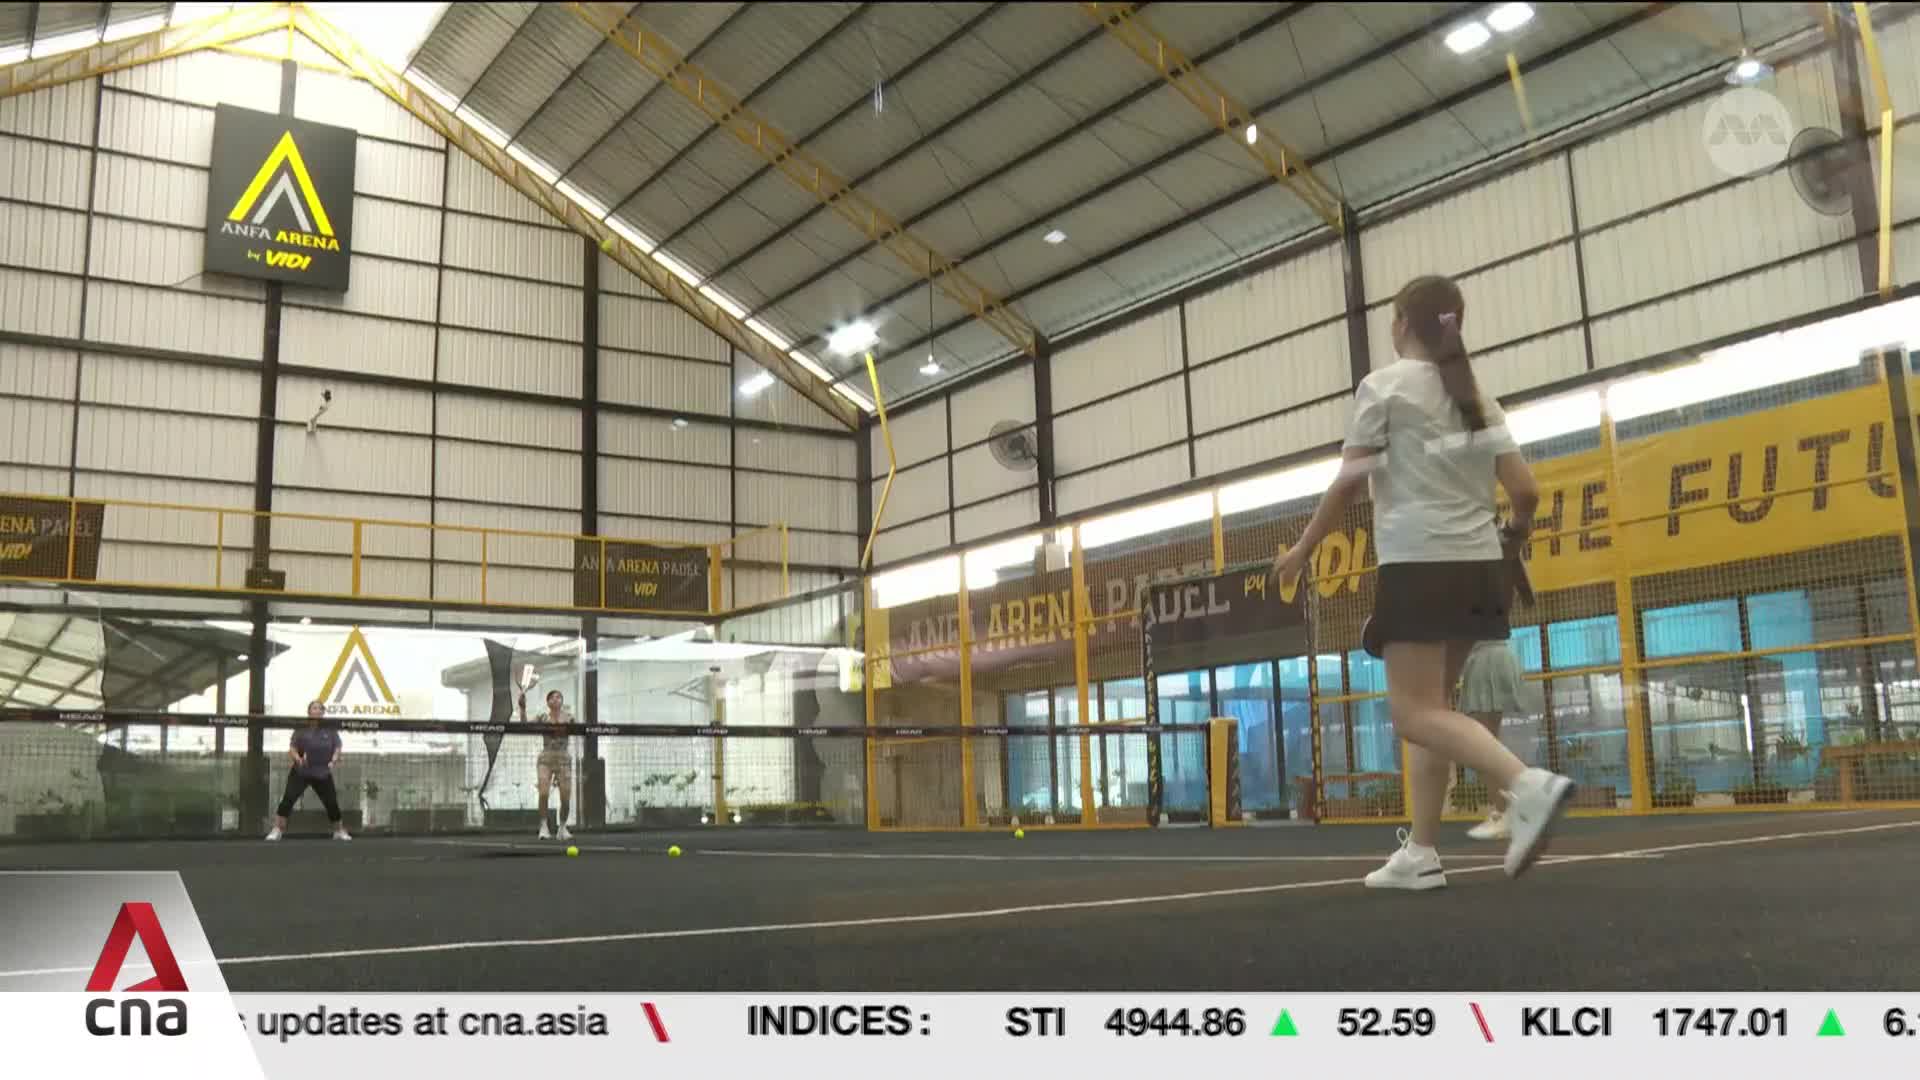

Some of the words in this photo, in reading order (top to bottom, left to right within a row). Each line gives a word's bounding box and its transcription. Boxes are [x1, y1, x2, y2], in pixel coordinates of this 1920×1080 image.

[220, 222, 272, 240] ANFA
[275, 230, 340, 251] ARENA
[265, 249, 312, 271] VIDI
[0, 516, 36, 534] ENA
[1518, 480, 1613, 561] HE
[580, 555, 615, 574] ANA
[617, 558, 660, 576] ARENA
[634, 581, 658, 597] VIDI
[352, 704, 401, 716] ARENA
